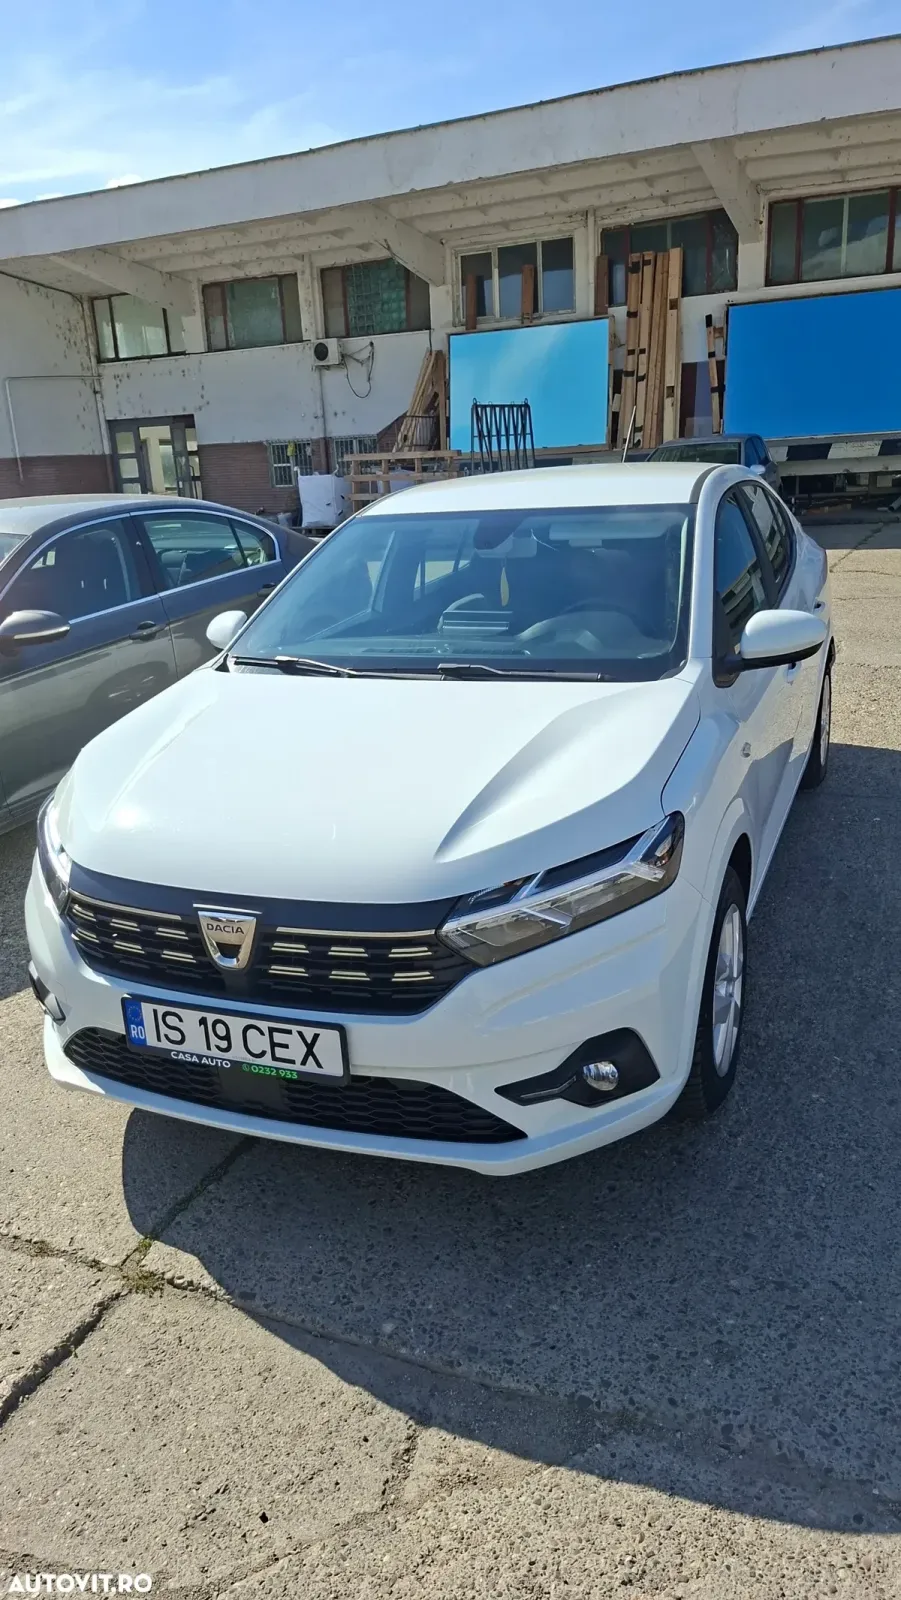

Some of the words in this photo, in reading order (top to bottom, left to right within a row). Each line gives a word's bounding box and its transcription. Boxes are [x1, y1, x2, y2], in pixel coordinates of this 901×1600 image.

[206, 923, 245, 934] DACIA
[130, 1024, 146, 1039] RO
[152, 1008, 187, 1046] IS
[198, 1016, 233, 1053] 19
[242, 1023, 324, 1069] CEX
[171, 1051, 200, 1063] CASA
[201, 1056, 231, 1068] AUTO
[251, 1064, 277, 1076] 0232
[279, 1069, 298, 1079] 933
